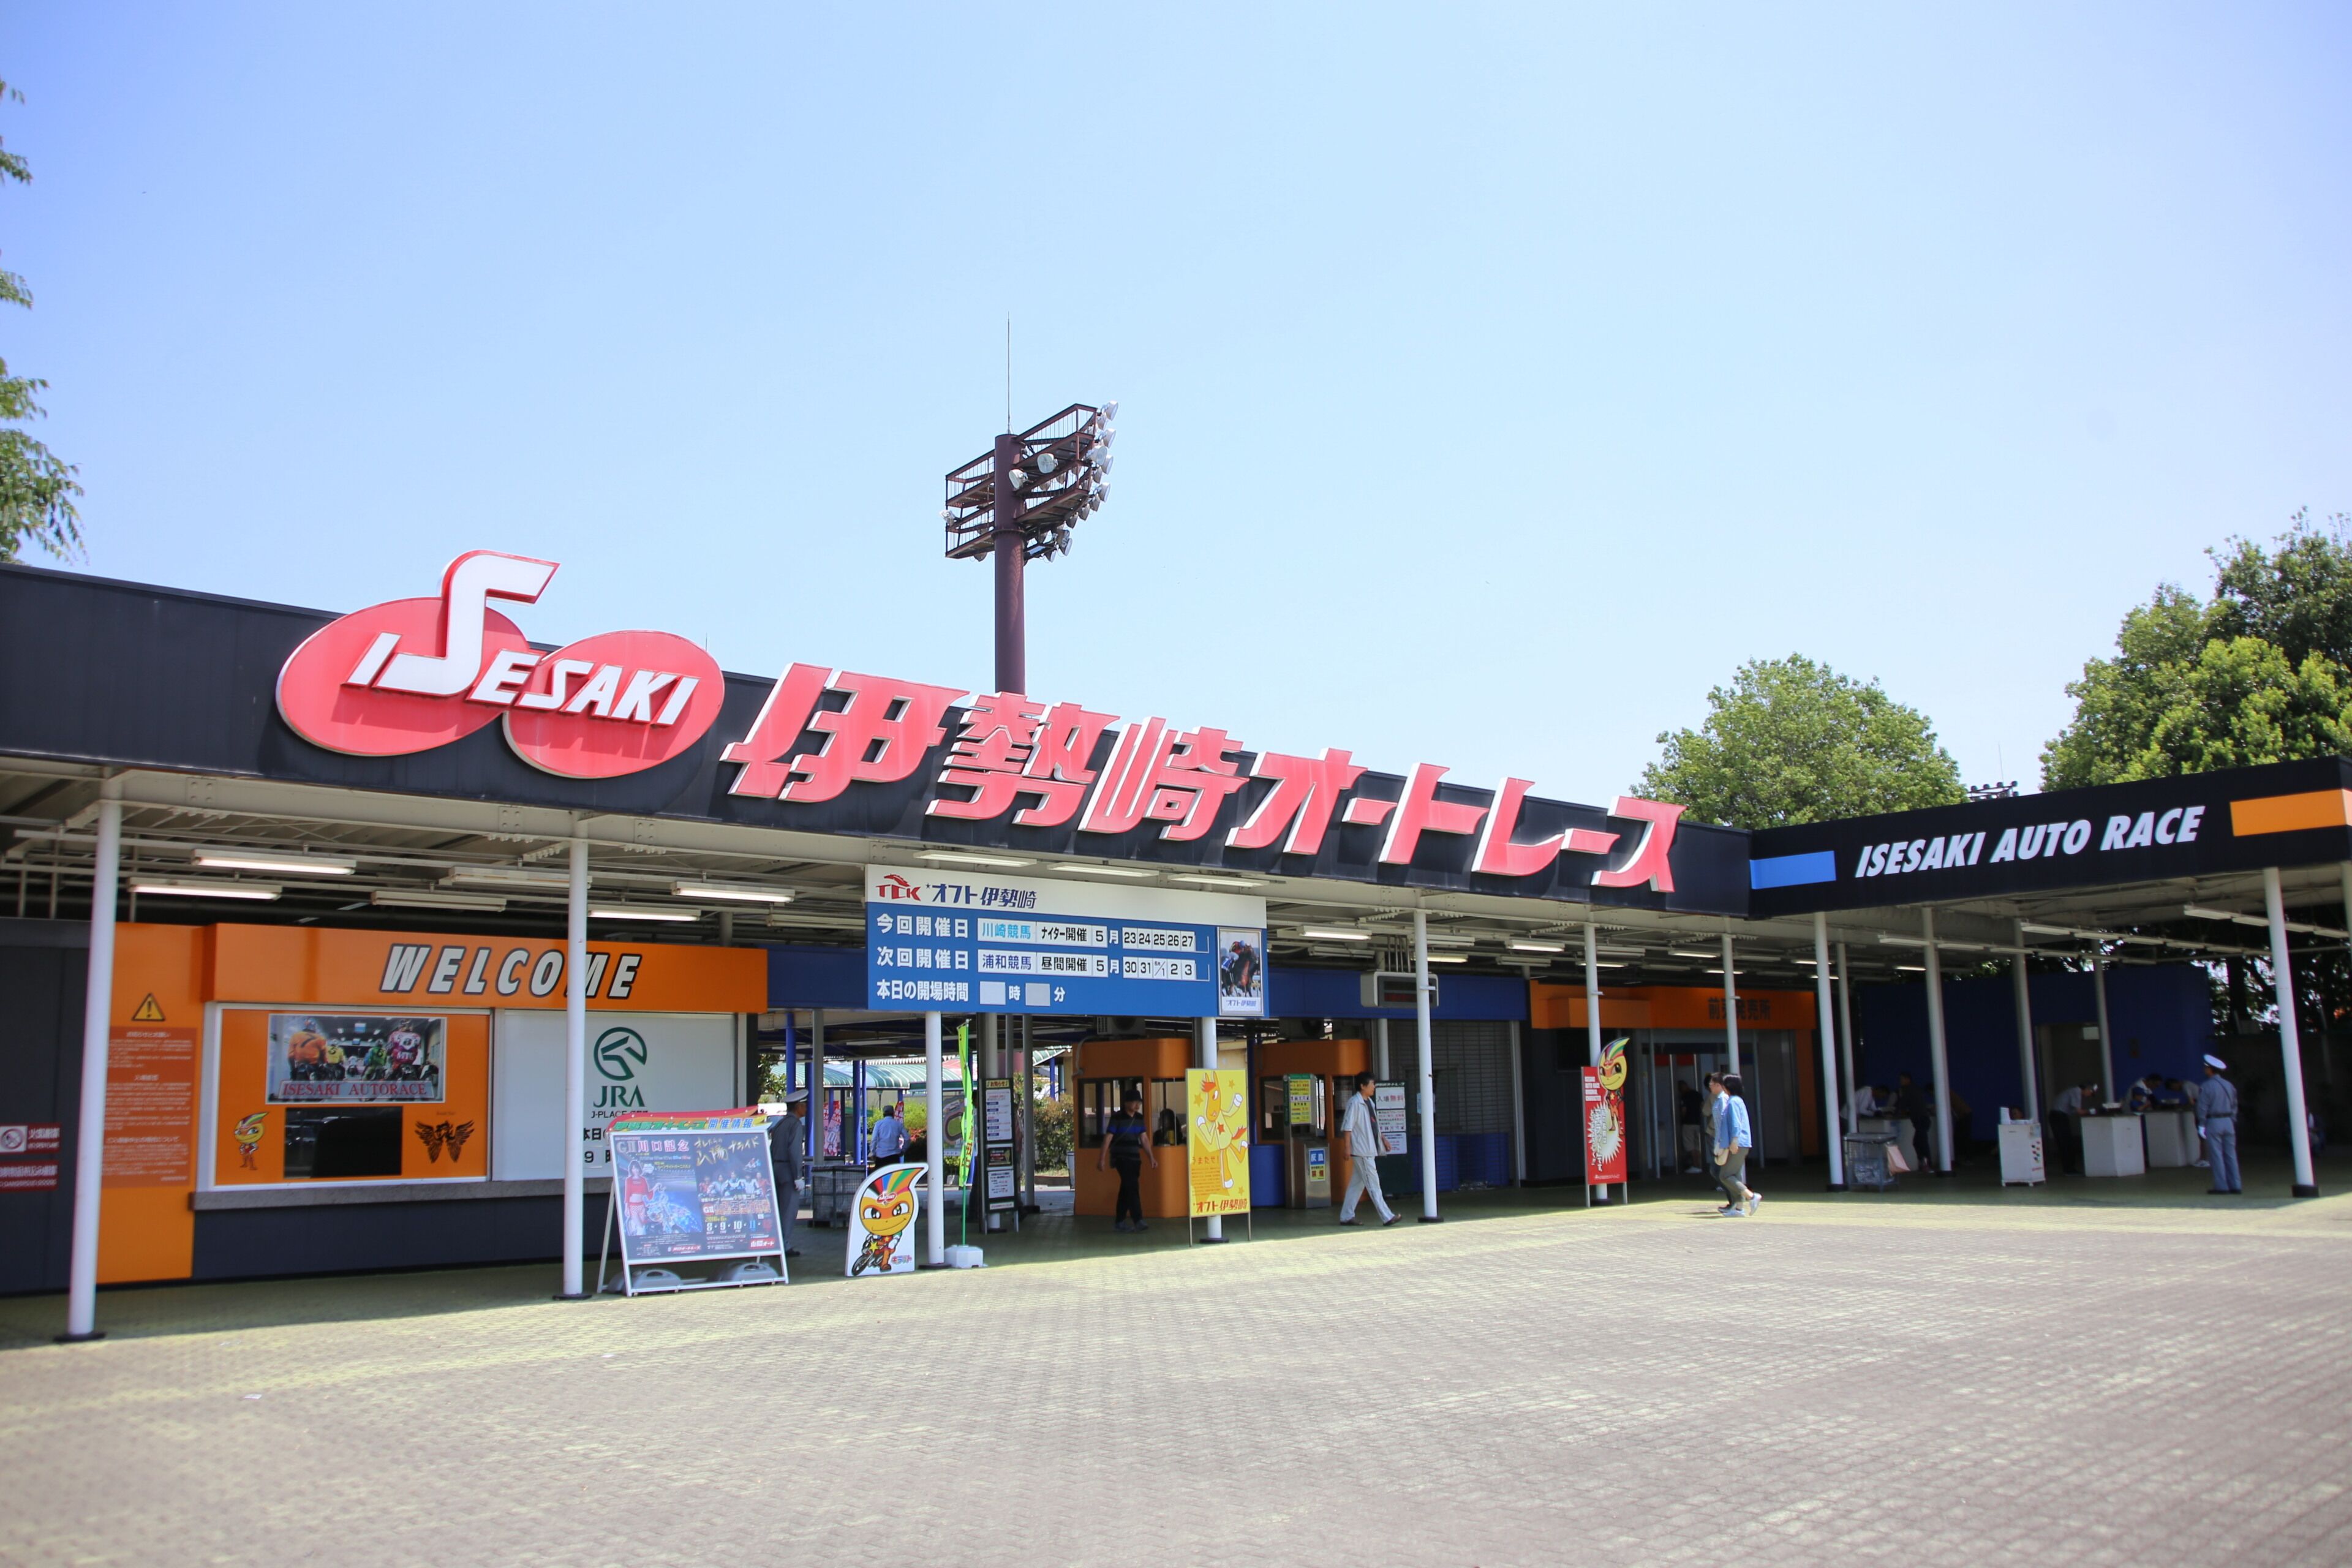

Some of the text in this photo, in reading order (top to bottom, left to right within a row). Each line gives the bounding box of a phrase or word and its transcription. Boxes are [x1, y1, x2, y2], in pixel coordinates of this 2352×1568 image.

[341, 549, 701, 726] ISESAKI
[720, 662, 1681, 893] 伊勢崎オートレース
[1855, 806, 2206, 878] ISESAKI AUTO RACE
[876, 883, 921, 902] TCK
[932, 883, 1037, 909] オフト伊勢崎
[876, 913, 1194, 948] 今回開催日 川崎競馬 ナイター開催 5 月 23 24 25 26 27
[380, 943, 642, 999] WELCOME
[876, 946, 969, 970] 次回開催日
[982, 954, 1031, 971] 浦和競馬
[1041, 956, 1088, 971] 昼間開催
[1096, 959, 1104, 972] 5
[1110, 959, 1120, 974] 月
[1125, 961, 1137, 973] 30
[1140, 962, 1152, 974] 31
[1170, 963, 1178, 975] 2
[1185, 963, 1193, 976] 3
[876, 978, 1066, 1003] 本日の開場時間 時 分
[283, 1083, 428, 1096] ISESAKI AUTORACE
[592, 1084, 646, 1108] JRA
[708, 1118, 755, 1129] 開催情報
[638, 1139, 690, 1153] 川口記念
